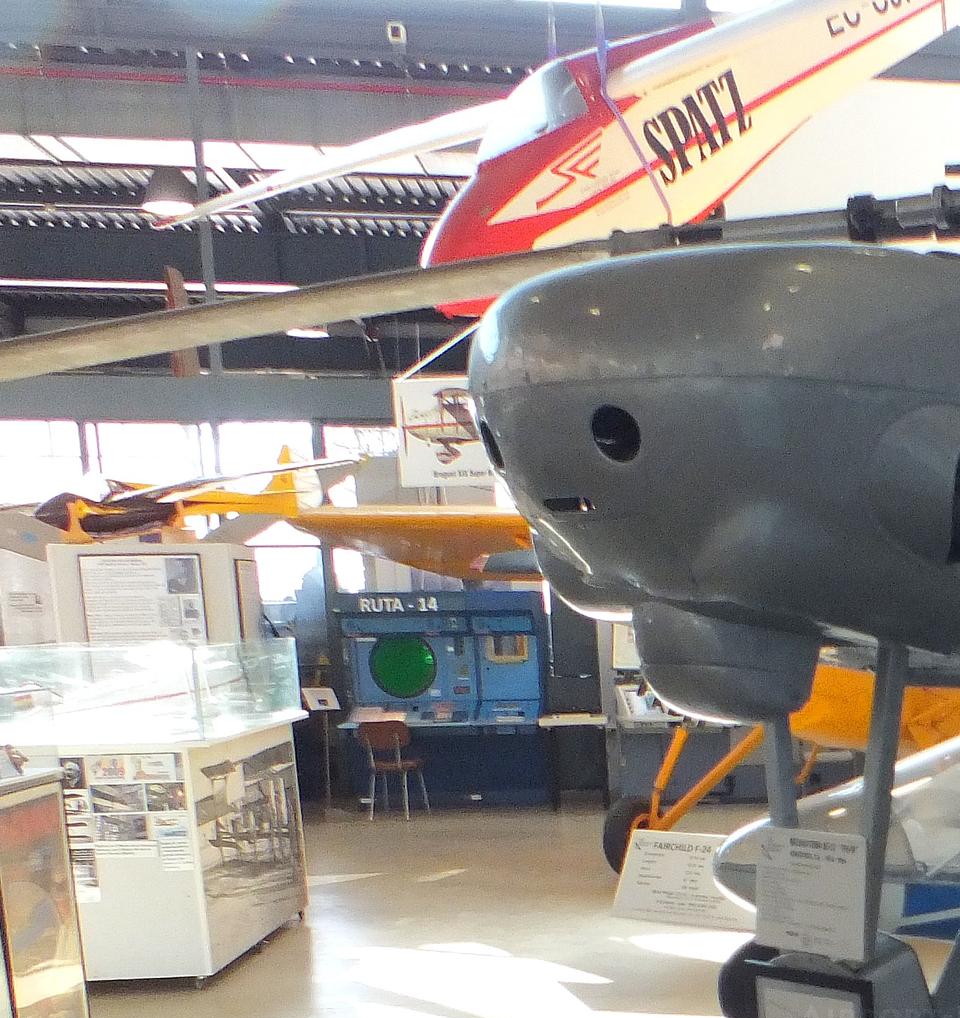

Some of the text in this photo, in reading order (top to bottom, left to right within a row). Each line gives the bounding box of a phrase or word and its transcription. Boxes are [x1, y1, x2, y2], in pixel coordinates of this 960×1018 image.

[643, 67, 753, 186] SPATZ
[359, 597, 405, 612] RUTA
[416, 596, 438, 612] 14
[653, 841, 693, 853] FAIRCHILD
